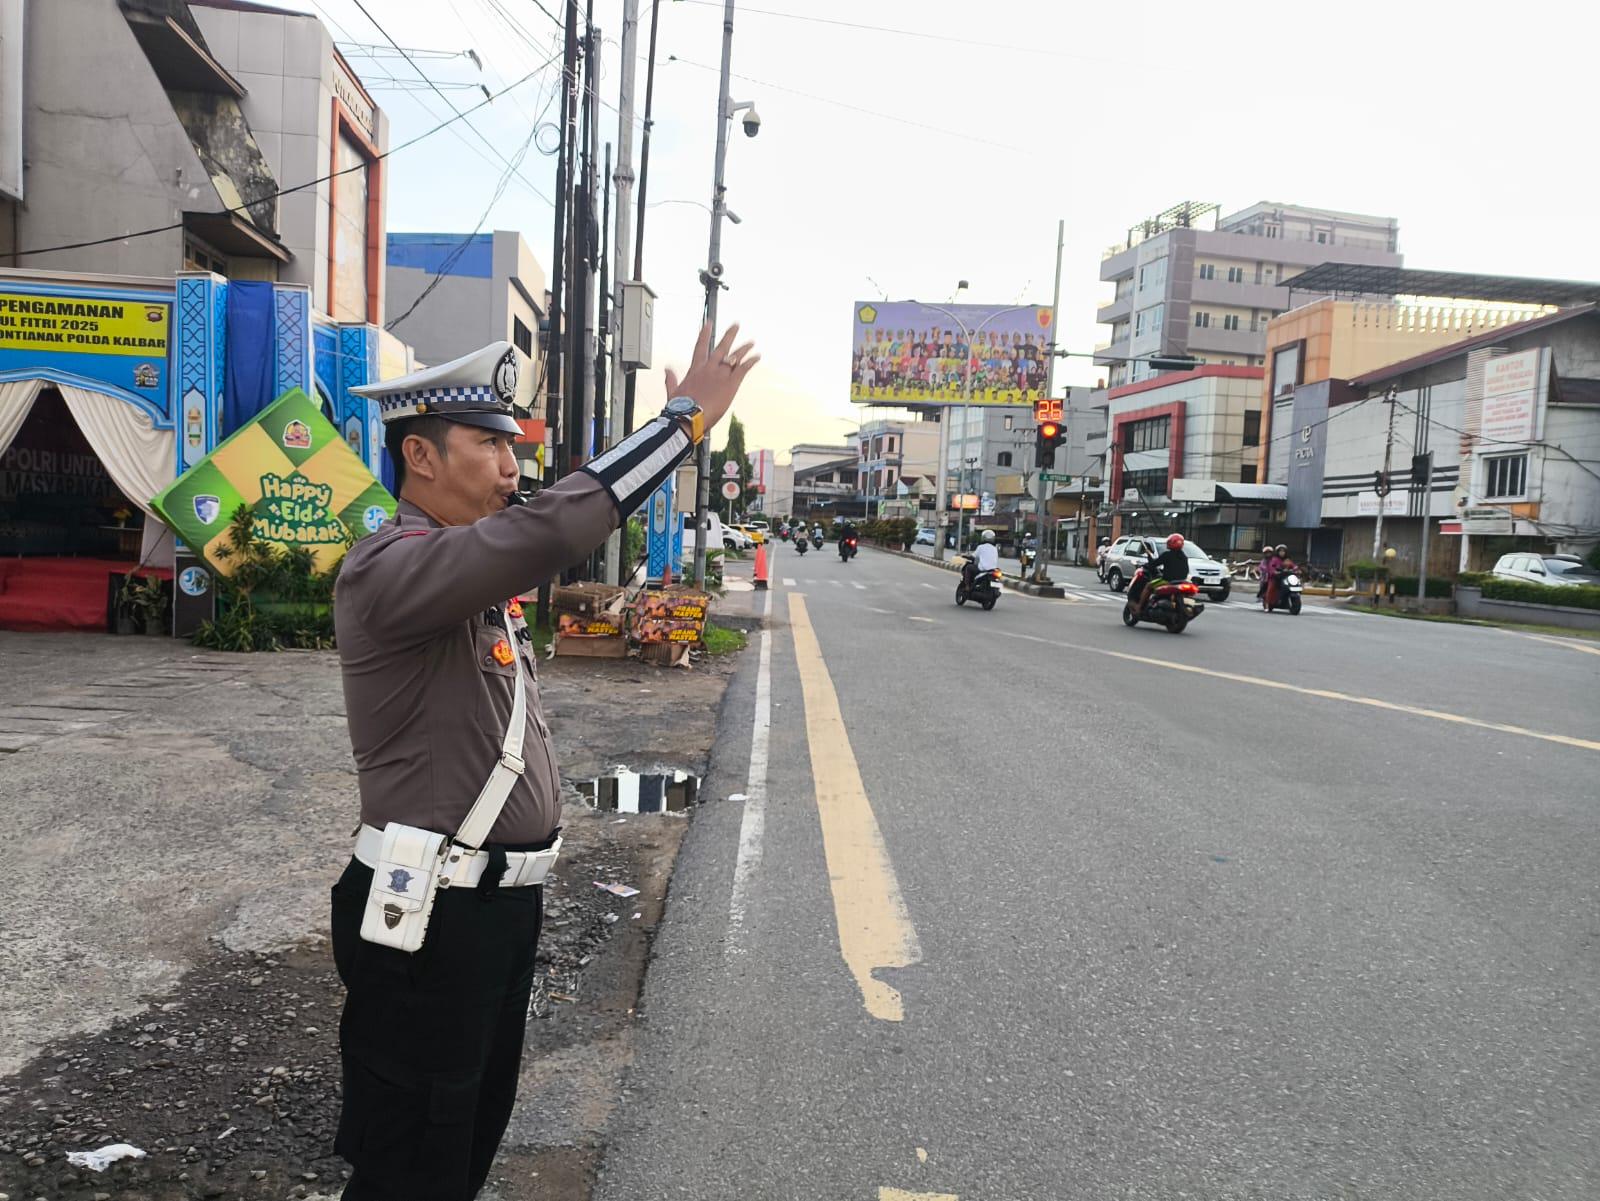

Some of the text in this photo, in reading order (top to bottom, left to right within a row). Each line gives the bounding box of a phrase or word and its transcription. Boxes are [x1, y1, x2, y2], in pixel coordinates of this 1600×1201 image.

[0, 299, 124, 319] PENGAMANAN
[20, 317, 57, 329] FITRI
[60, 319, 99, 332] 2025
[67, 333, 110, 345] POLDA
[113, 336, 166, 348] KALBAR
[1038, 401, 1062, 420] 26
[5, 447, 57, 473] POLRI
[262, 478, 330, 507] Happy
